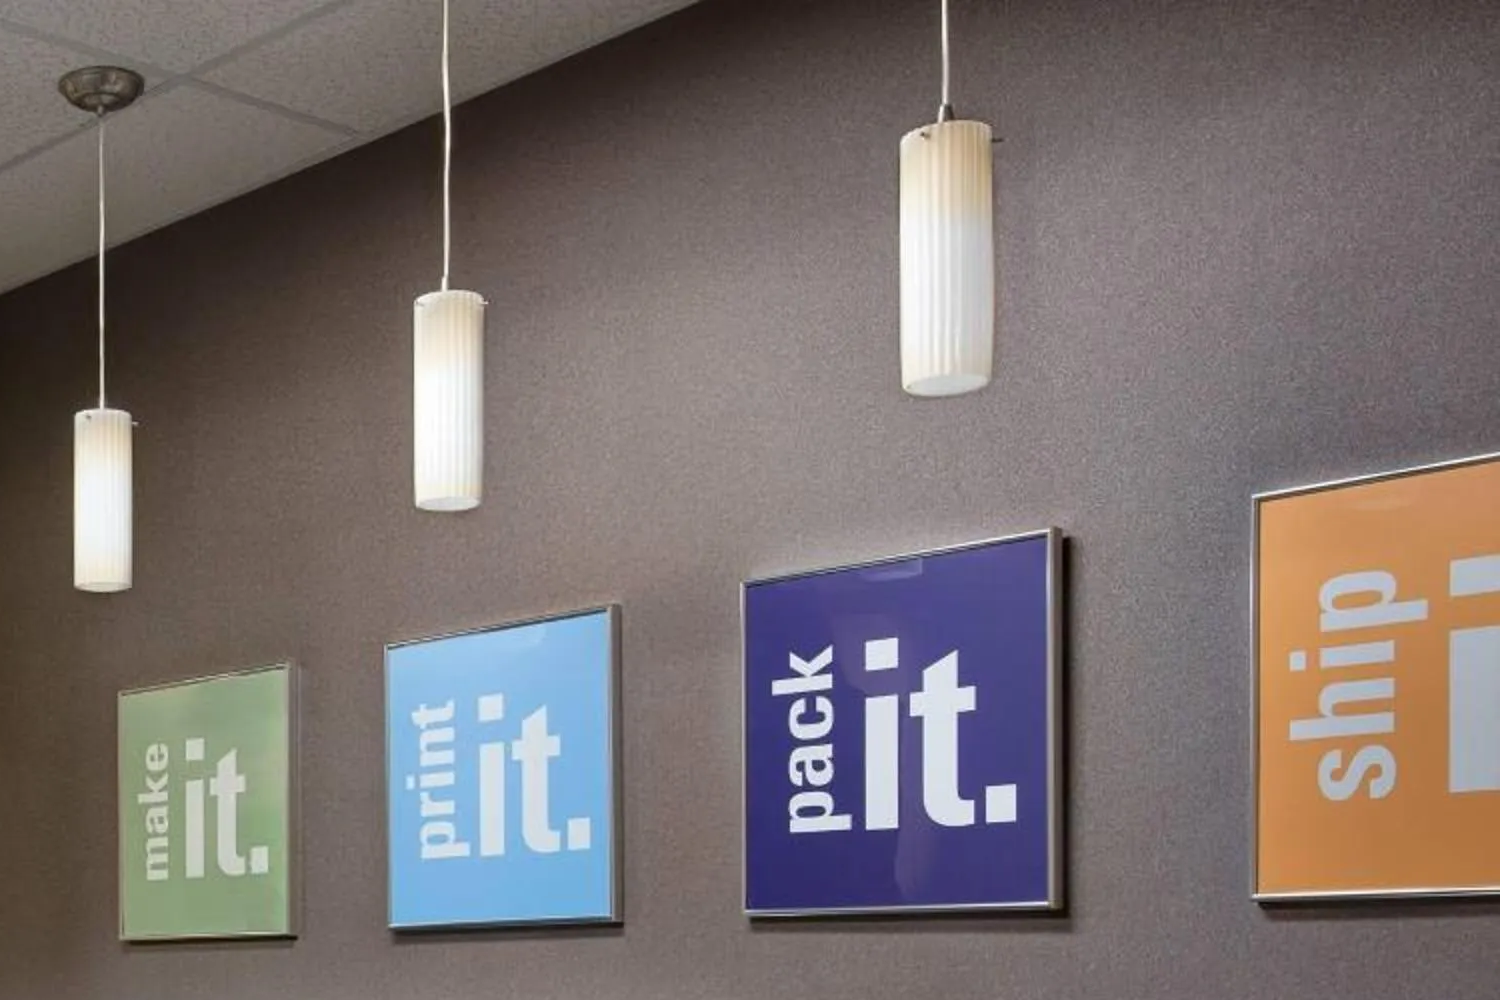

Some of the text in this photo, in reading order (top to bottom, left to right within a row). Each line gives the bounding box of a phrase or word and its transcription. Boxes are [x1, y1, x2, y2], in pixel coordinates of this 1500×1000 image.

[771, 637, 1017, 833] pack it.
[1288, 570, 1429, 801] ship
[137, 737, 269, 881] make it.
[406, 693, 591, 860] print it.
